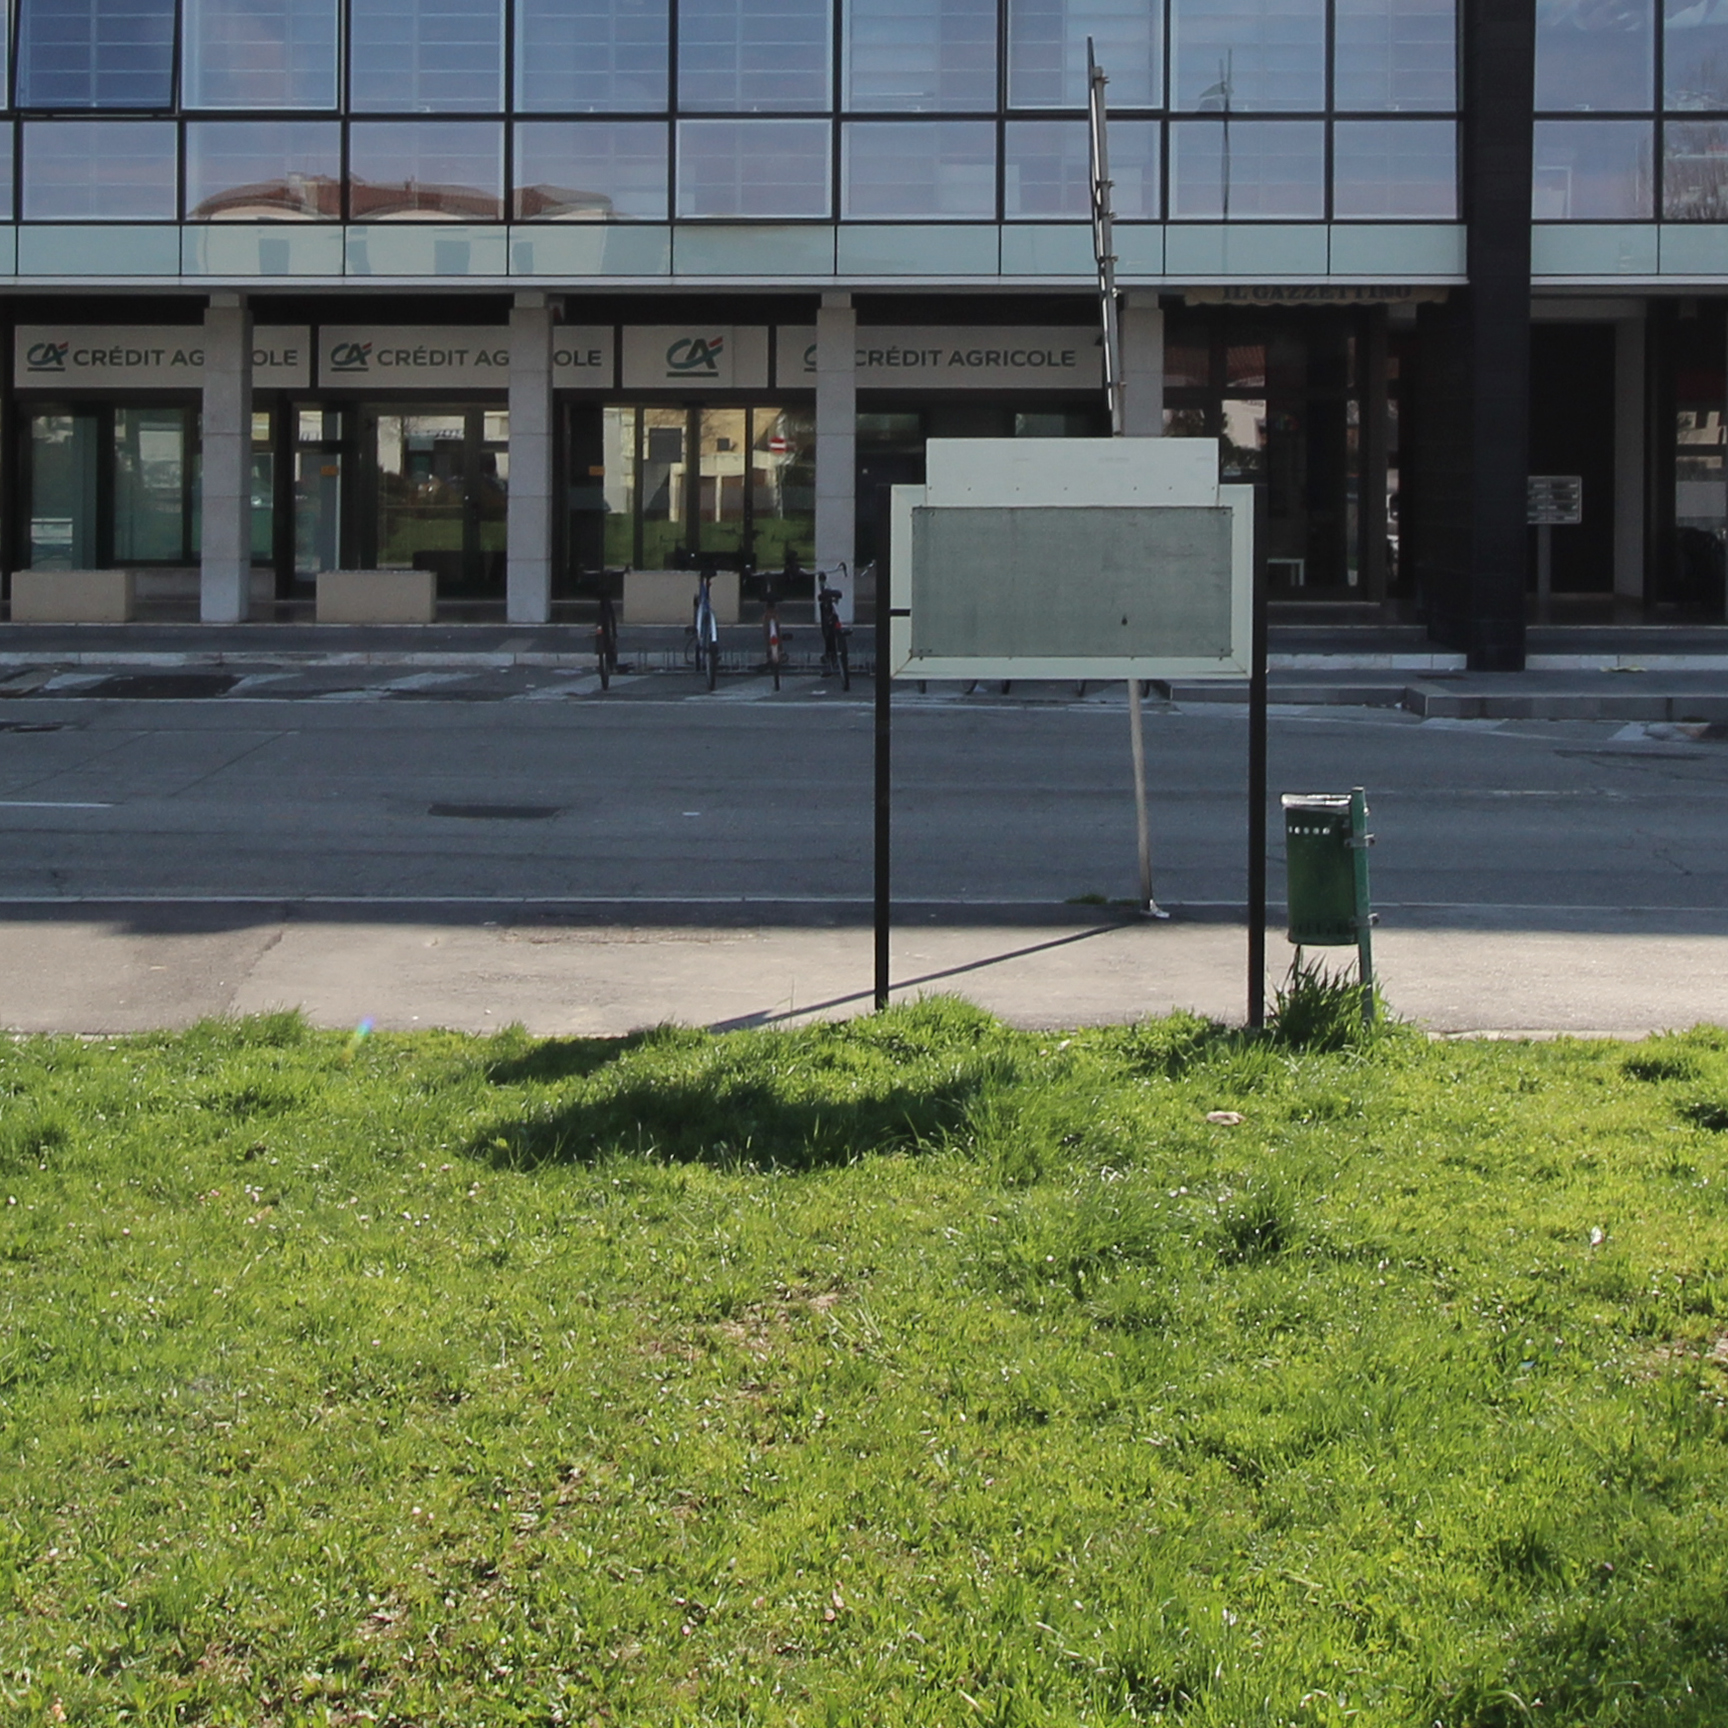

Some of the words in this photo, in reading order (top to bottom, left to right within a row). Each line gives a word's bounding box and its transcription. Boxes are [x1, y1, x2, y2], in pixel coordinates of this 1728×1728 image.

[73, 345, 165, 366] CRÉDIT
[377, 345, 468, 366] CRÉDIT
[855, 345, 943, 368] CRÉDIT
[948, 349, 1076, 368] AGRICOLE
